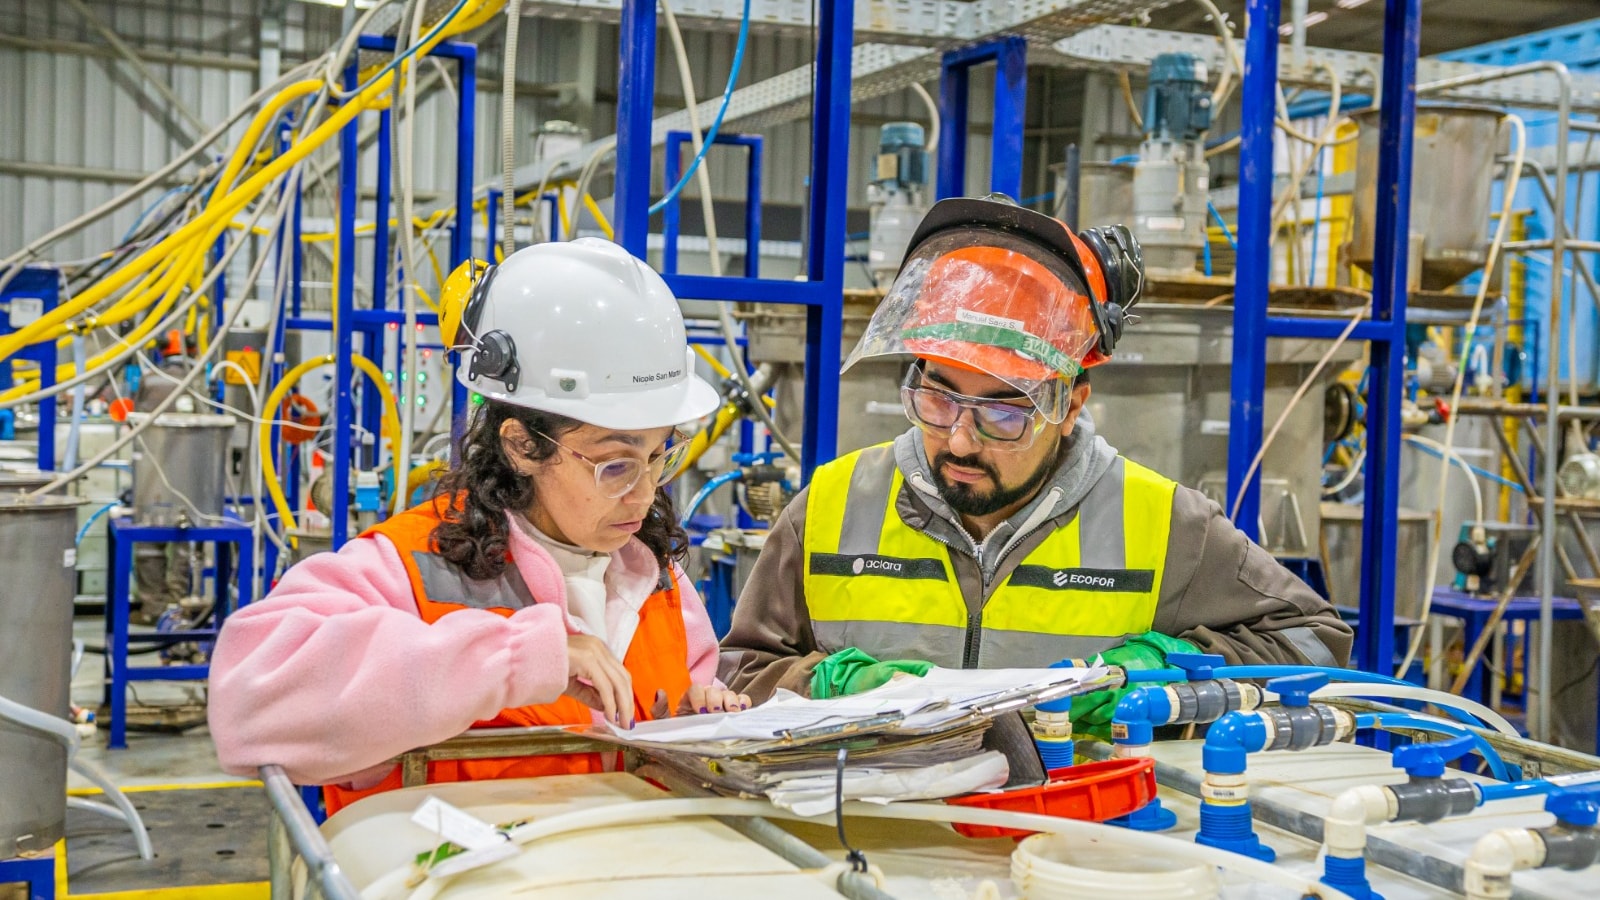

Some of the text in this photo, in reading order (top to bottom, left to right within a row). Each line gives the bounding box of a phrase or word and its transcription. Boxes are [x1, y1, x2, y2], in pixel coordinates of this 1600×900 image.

[632, 374, 655, 384] Nicole
[655, 372, 668, 381] San
[865, 559, 902, 571] aclara
[1069, 574, 1115, 587] ECOFOR
